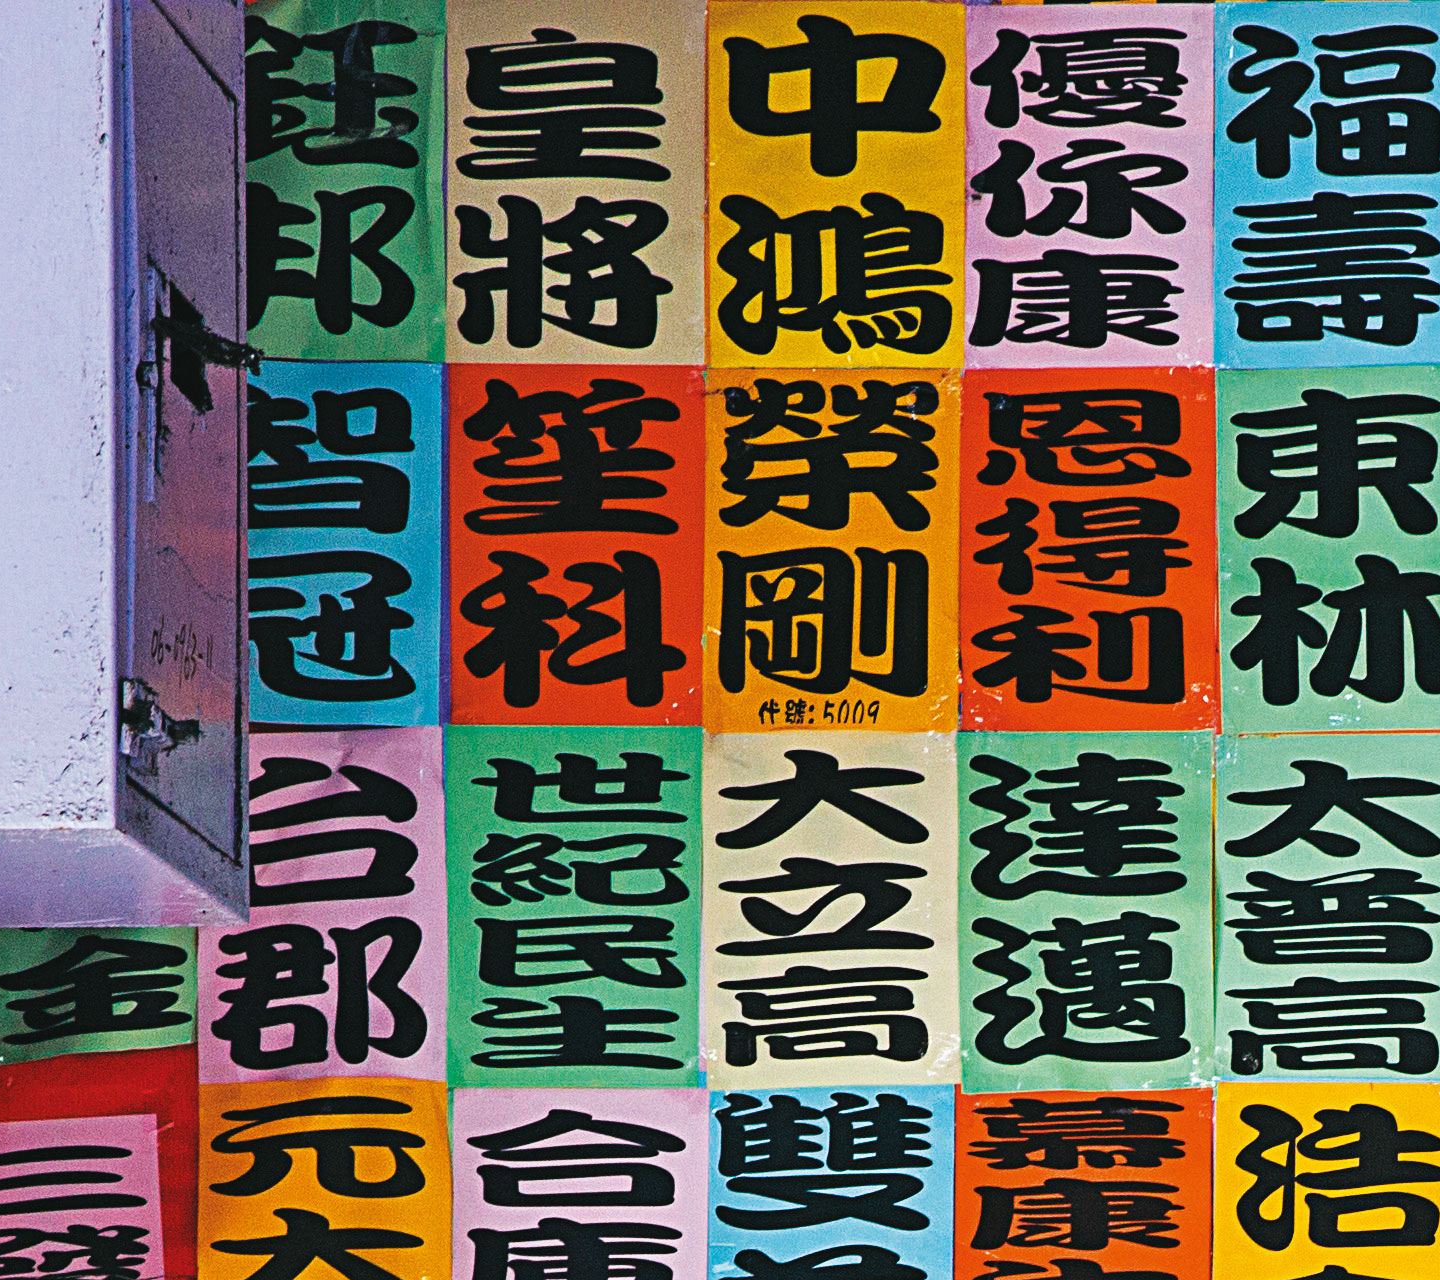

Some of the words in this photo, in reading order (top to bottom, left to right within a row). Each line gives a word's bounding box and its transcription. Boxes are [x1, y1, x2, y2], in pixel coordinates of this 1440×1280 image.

[453, 28, 673, 348] 皇將
[717, 15, 953, 354] 中鴻
[969, 28, 1188, 348] 優你康
[250, 385, 416, 702] 智冠
[460, 379, 686, 708] 笙科
[718, 379, 939, 698] 榮剛
[972, 389, 1192, 704] 恩得利
[212, 756, 427, 1070] 台郡
[471, 753, 690, 1069] 世紀民生
[716, 750, 934, 1066] 大立高
[969, 753, 1190, 1064] 達邁
